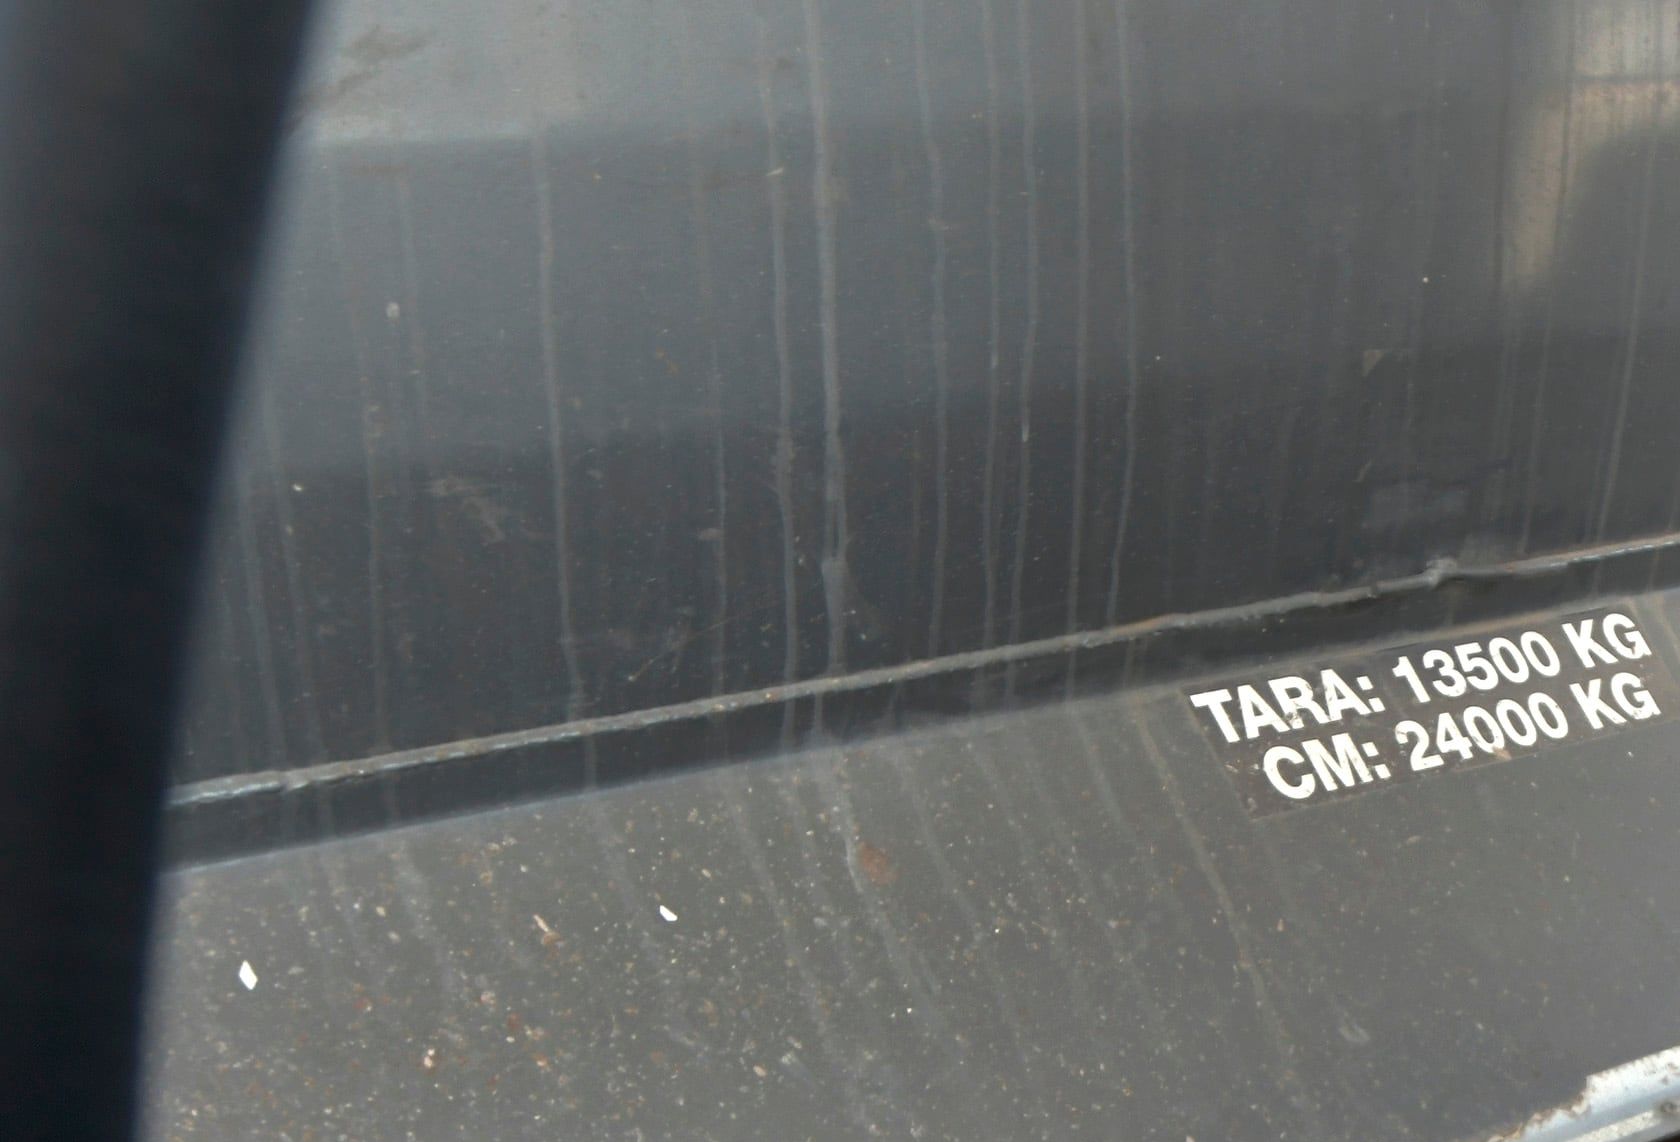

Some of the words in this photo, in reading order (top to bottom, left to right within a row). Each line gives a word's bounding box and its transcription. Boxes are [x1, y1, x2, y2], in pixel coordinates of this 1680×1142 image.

[1191, 668, 1385, 743] TARA:
[1392, 631, 1562, 704] 13500
[1562, 613, 1652, 668] KG
[1263, 733, 1391, 799] CM:
[1395, 691, 1569, 772] 24000
[1570, 672, 1661, 729] KG
